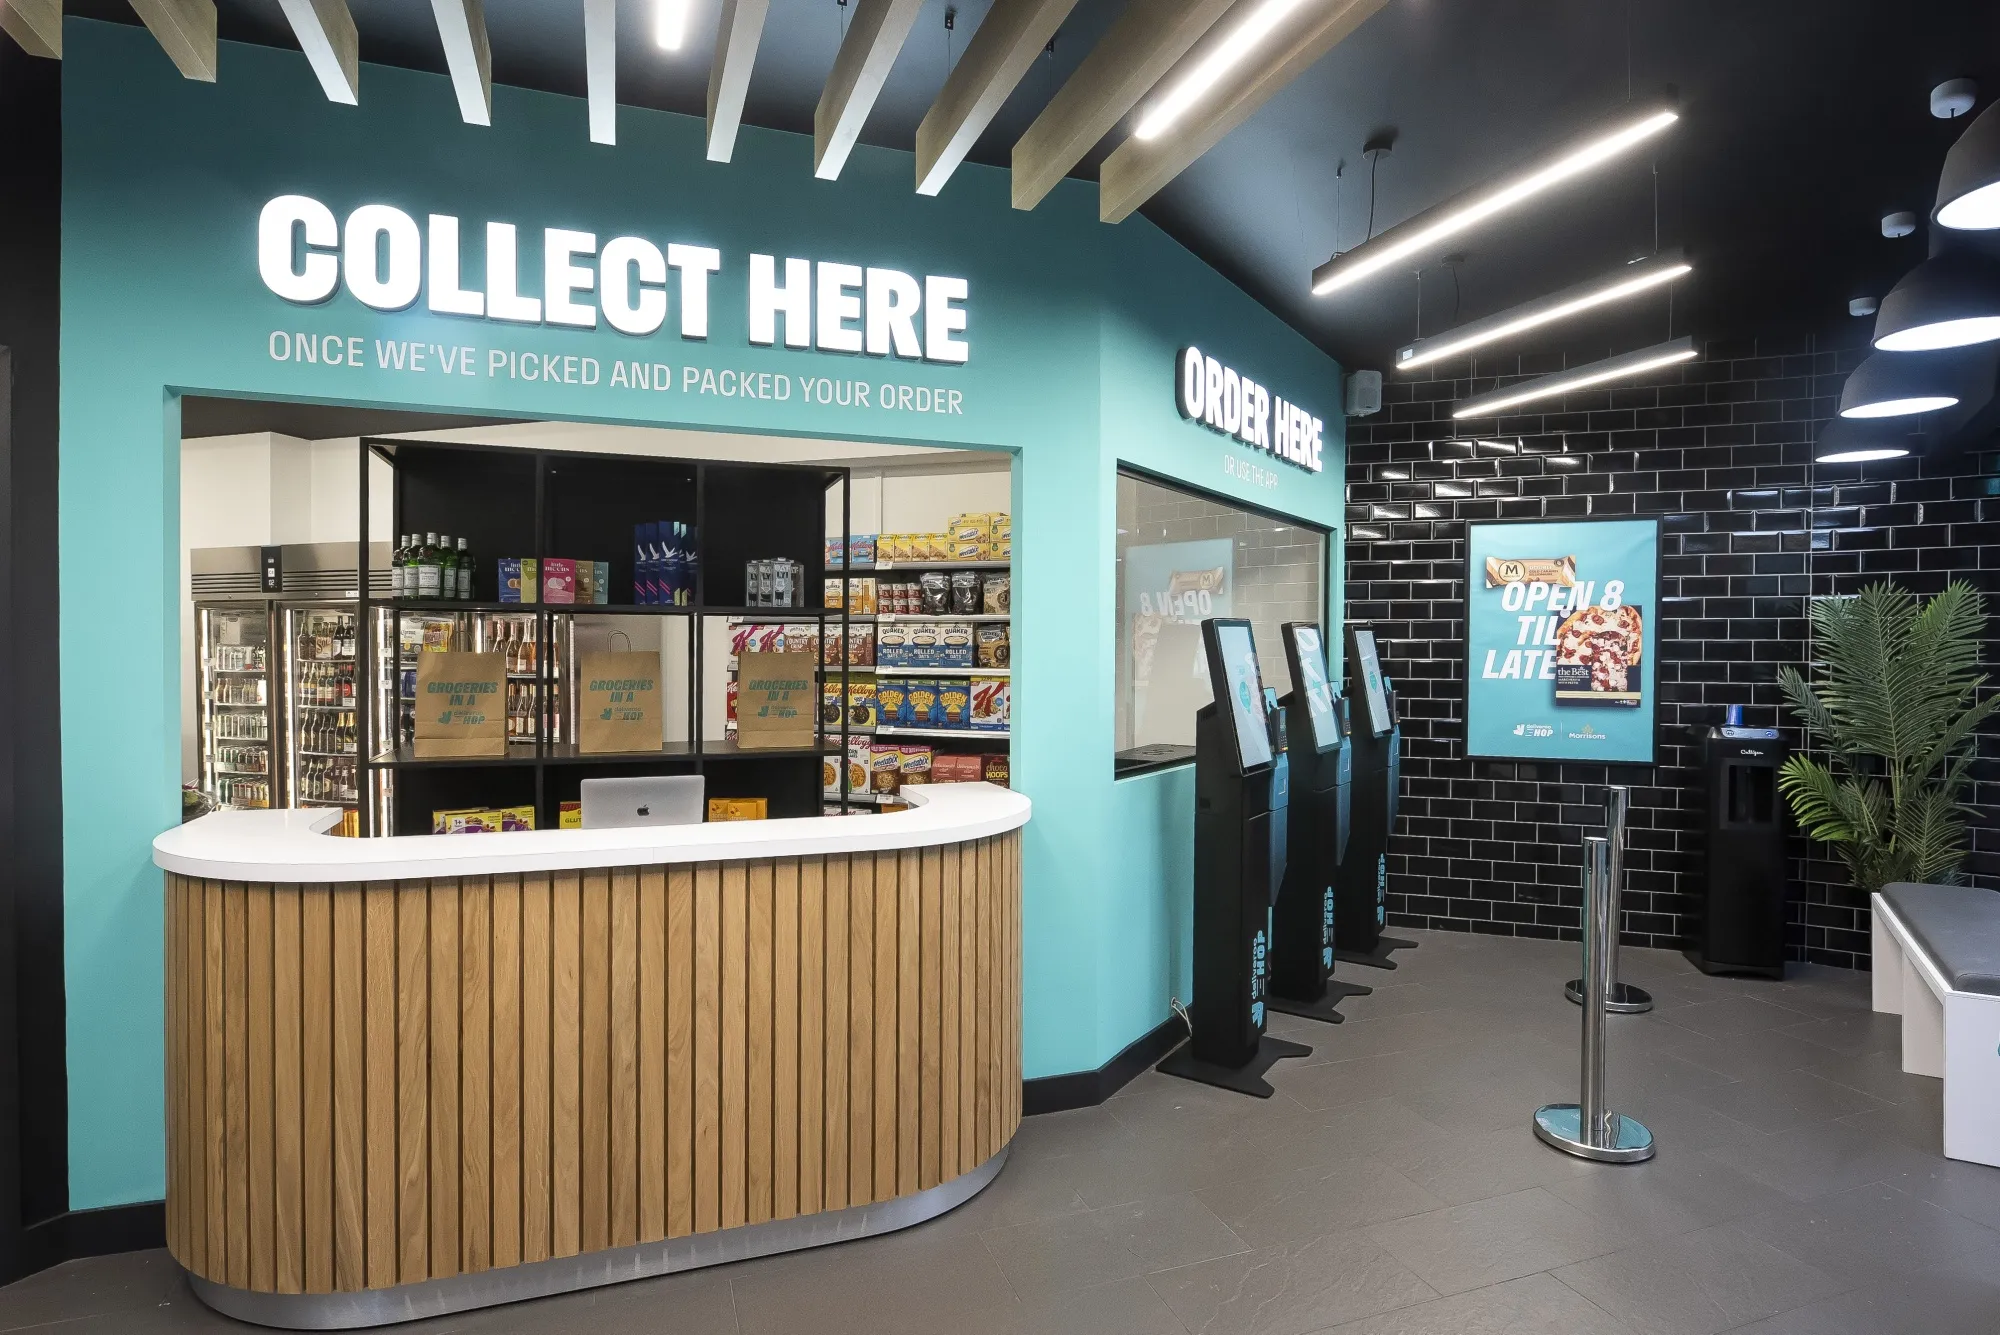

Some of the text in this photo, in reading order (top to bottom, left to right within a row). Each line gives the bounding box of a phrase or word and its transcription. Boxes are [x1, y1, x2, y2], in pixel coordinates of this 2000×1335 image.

[258, 194, 969, 366] COLLECT HERE
[269, 330, 963, 415] ONCE WE'VE PICKED AND PACKED YOUR ORDER
[1183, 346, 1323, 473] ORDER HERE
[1224, 454, 1278, 491] OR USE THE APP
[1505, 564, 1519, 575] M
[1501, 579, 1625, 612] OPEN 8
[882, 627, 905, 635] QUAKER
[913, 627, 936, 635] QUAKER
[944, 627, 968, 635] QUAKER
[1517, 615, 1560, 646] TIL
[1482, 649, 1557, 680] LATE
[1558, 666, 1589, 676] the Best
[427, 681, 498, 693] GROCERIES
[589, 680, 654, 691] GROCERIES
[749, 680, 809, 691] GROCERIES
[449, 694, 476, 706] IN A
[610, 692, 634, 703] IN A
[767, 691, 790, 701] IN A
[623, 711, 644, 721] HOP
[778, 710, 798, 718] HOP
[463, 716, 485, 725] HOP
[1533, 729, 1606, 740] HOP Morrisons
[986, 761, 1008, 772] choco
[985, 771, 1009, 779] HOOPS
[1326, 886, 1334, 925] HOP
[1257, 930, 1266, 975] HOP
